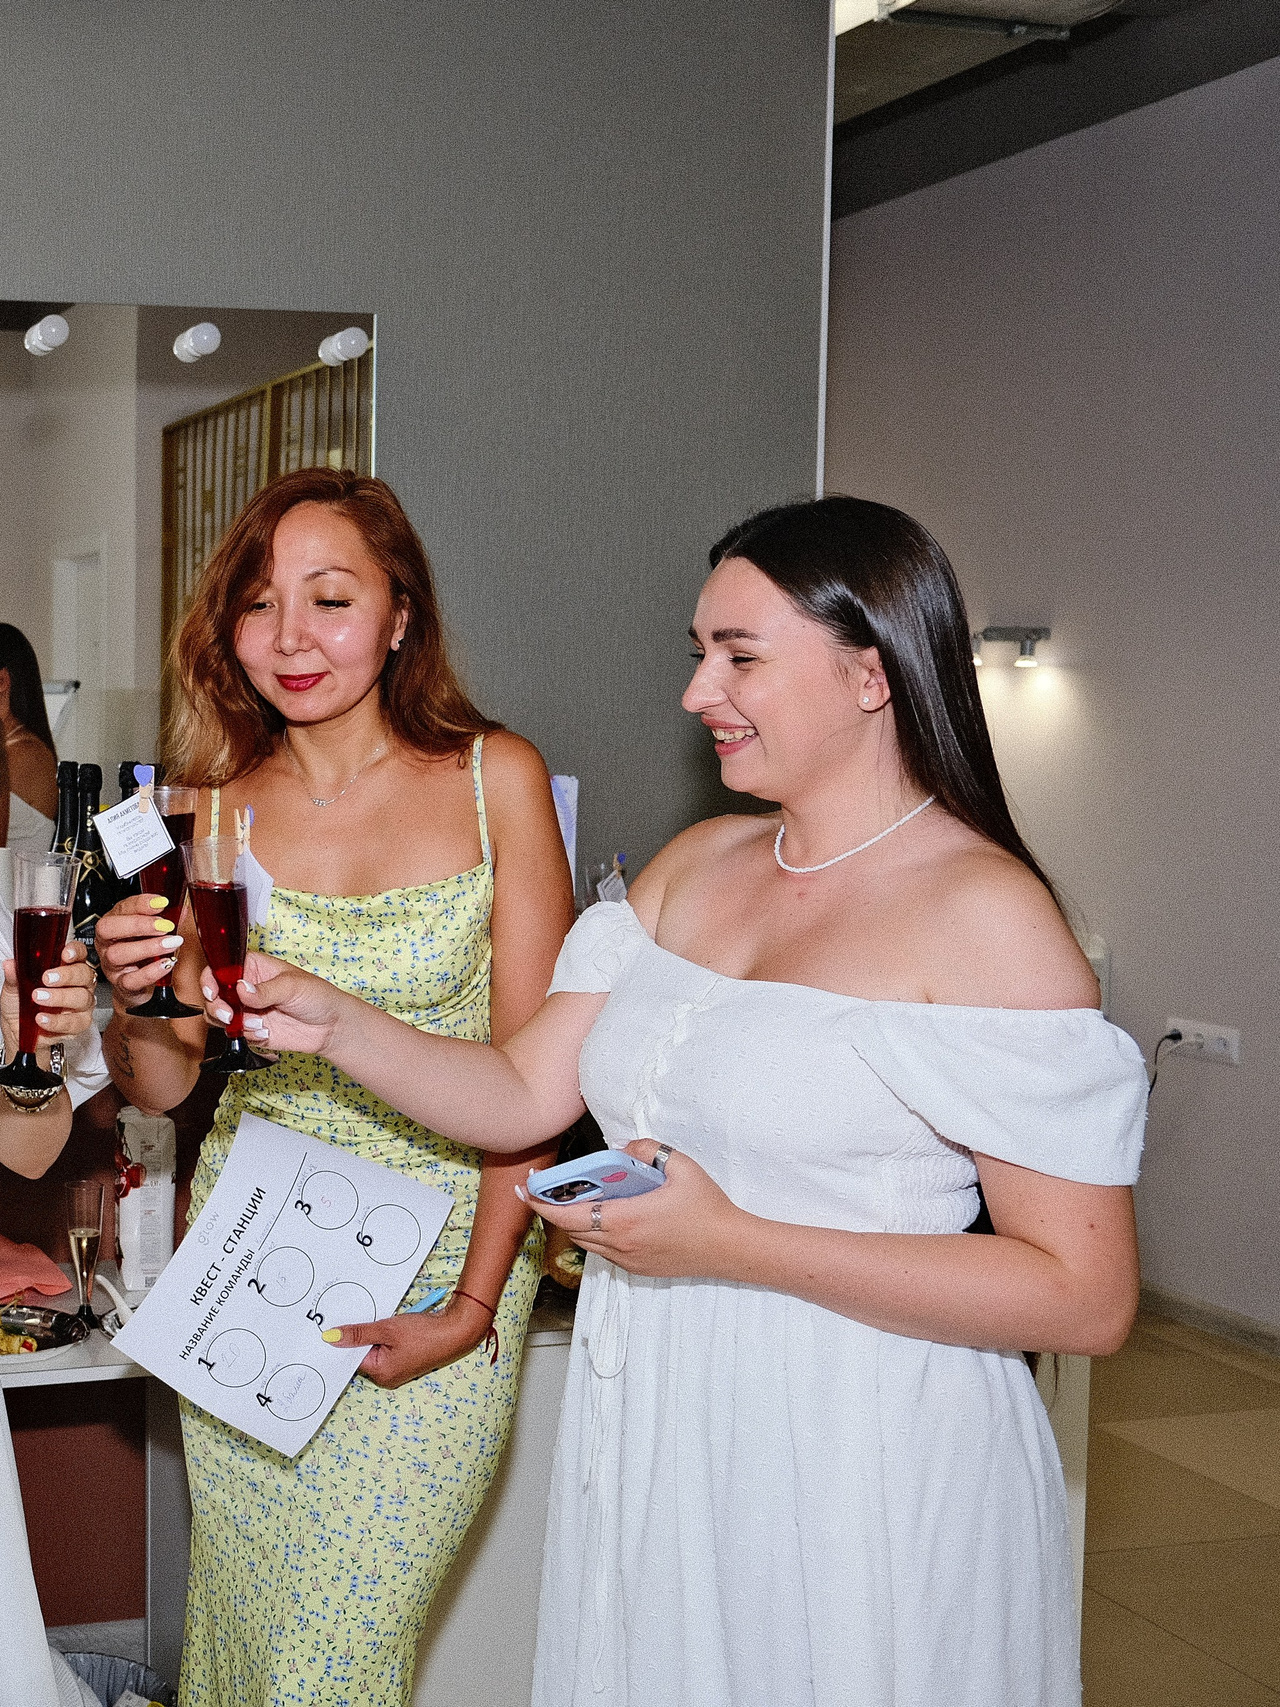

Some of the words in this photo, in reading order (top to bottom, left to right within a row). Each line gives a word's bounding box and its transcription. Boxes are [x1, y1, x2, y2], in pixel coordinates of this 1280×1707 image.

[295, 1200, 311, 1215] 3
[190, 1263, 221, 1305] КВЕСТ
[223, 1187, 266, 1253] СТАНЦИИ
[357, 1232, 372, 1247] 6
[248, 1279, 265, 1294] 2
[179, 1307, 219, 1360] НАЗВАНИЕ
[216, 1249, 254, 1306] КОМАНДЫ
[306, 1310, 323, 1325] 5
[198, 1358, 215, 1371] 1
[256, 1393, 272, 1407] 4
